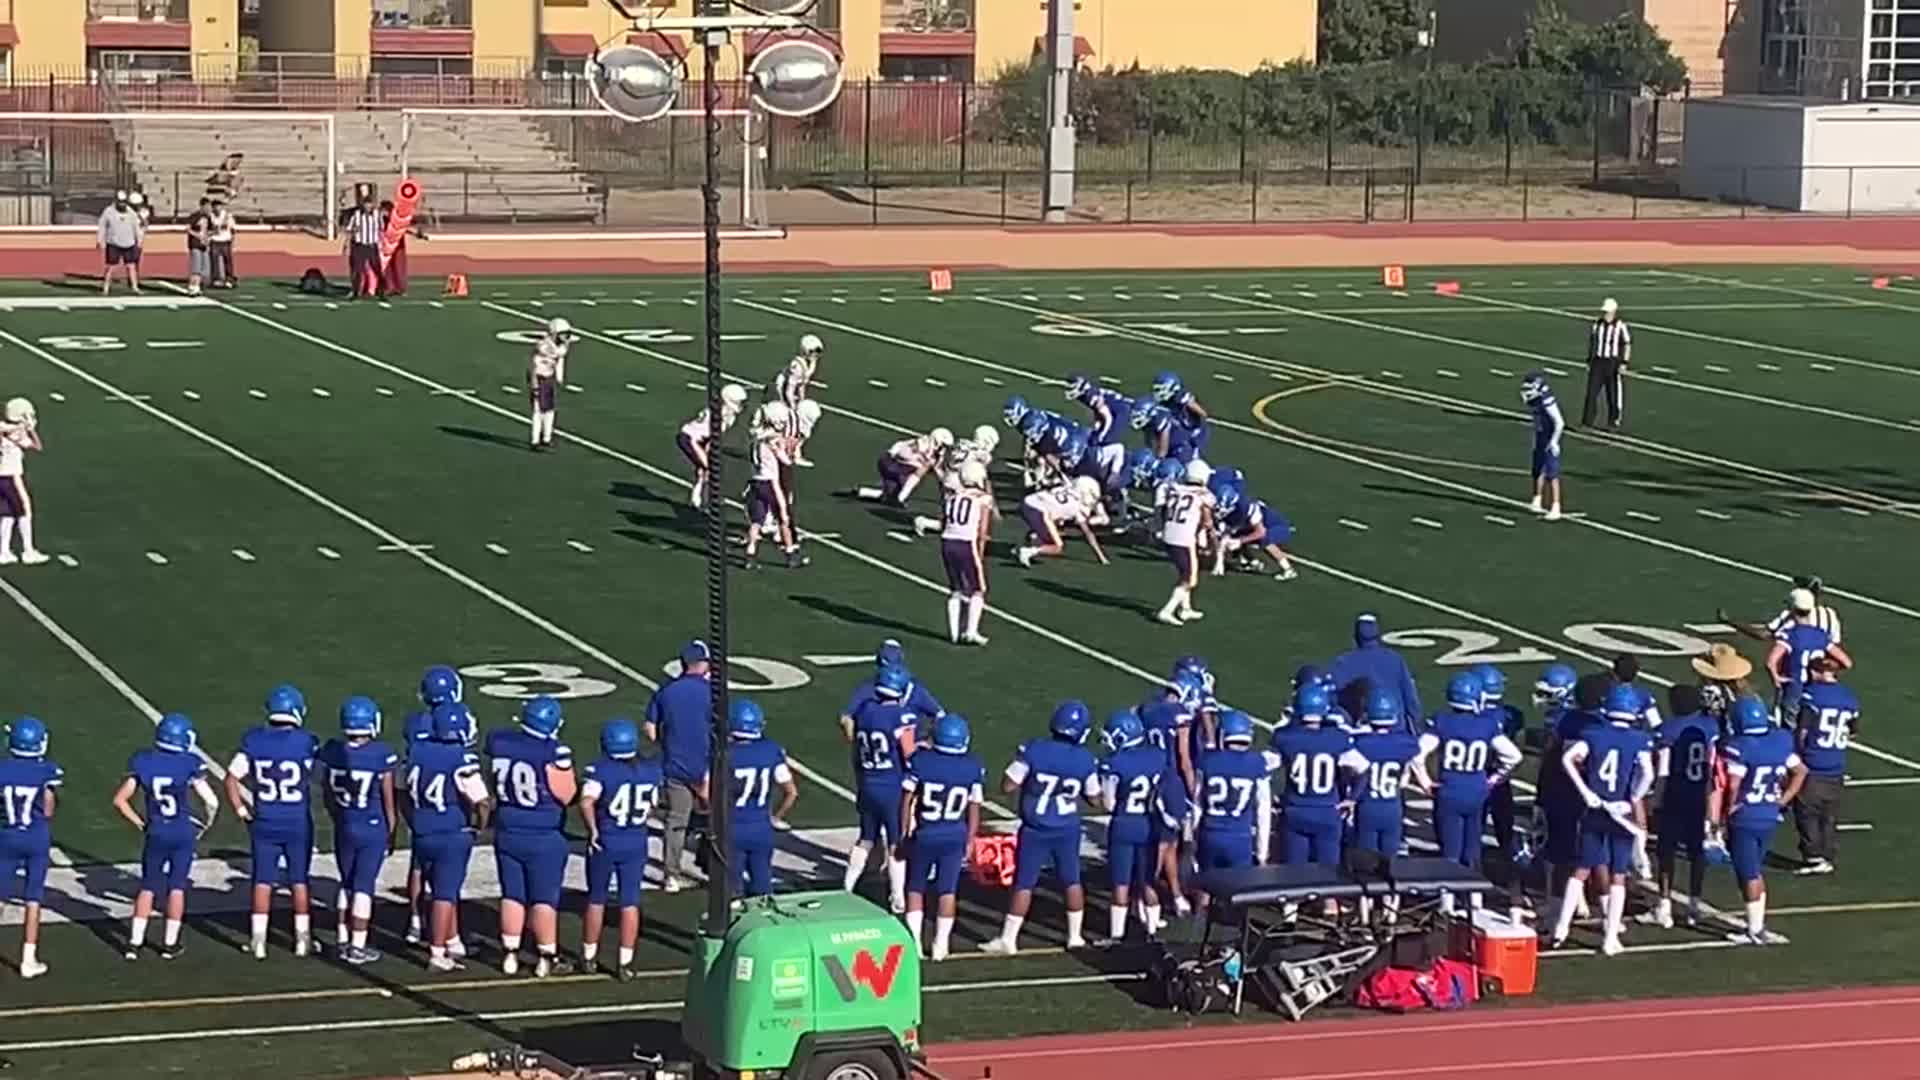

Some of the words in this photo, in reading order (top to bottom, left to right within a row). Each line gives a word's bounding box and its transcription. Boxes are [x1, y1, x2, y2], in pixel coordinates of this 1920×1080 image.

[1817, 708, 1852, 749] 56
[1290, 753, 1334, 795] 40
[1444, 740, 1487, 772] 80
[1599, 749, 1620, 792] 4
[152, 776, 178, 817] 5
[255, 760, 303, 802] 52
[329, 769, 374, 808] 57
[491, 758, 538, 807] 78
[735, 767, 771, 807] 71
[1036, 773, 1081, 815] 72
[1207, 777, 1253, 816] 27
[3, 786, 38, 825] 17
[609, 783, 650, 827] 45
[921, 783, 969, 821] 50
